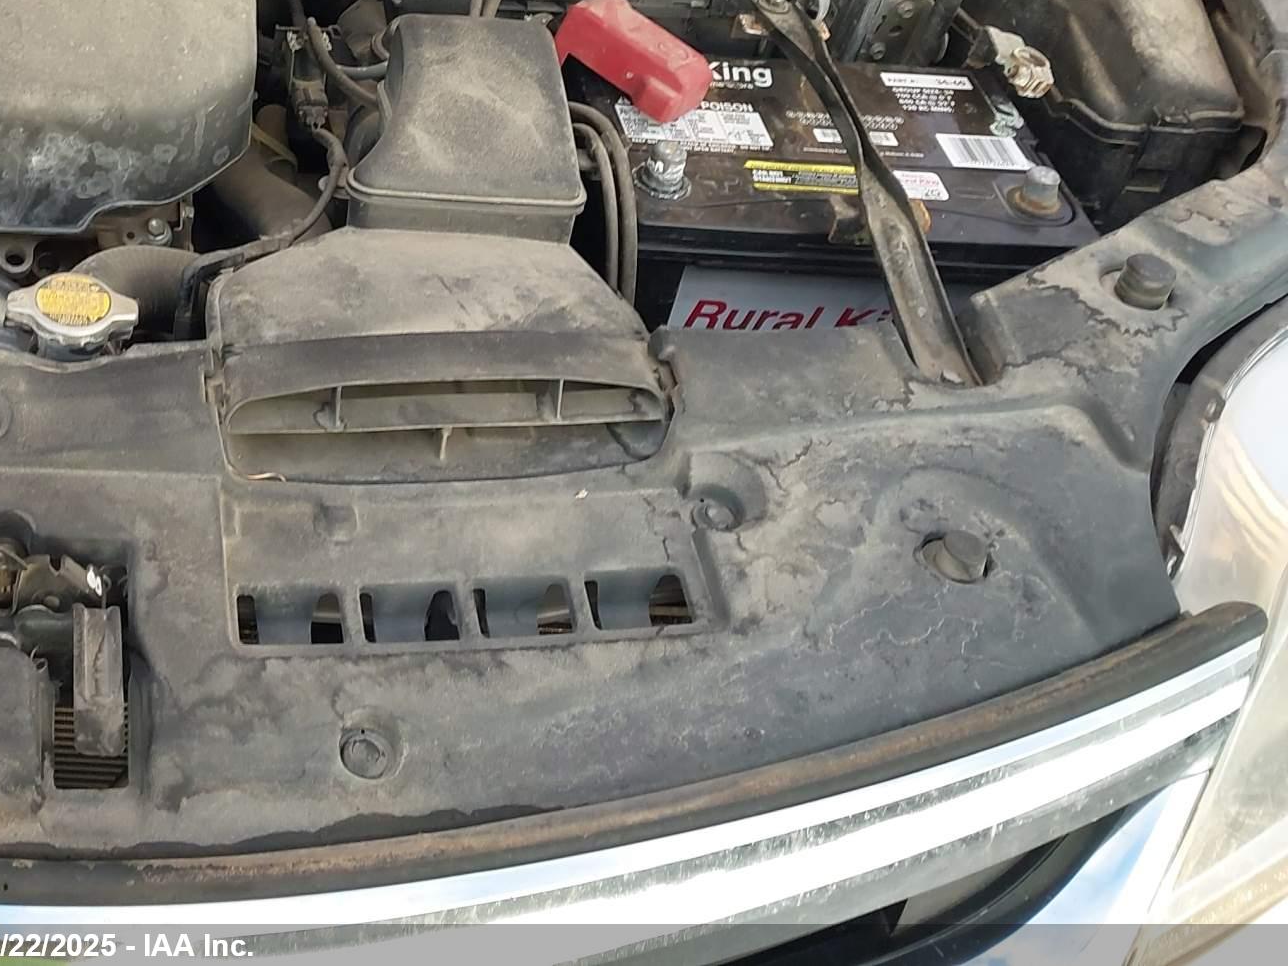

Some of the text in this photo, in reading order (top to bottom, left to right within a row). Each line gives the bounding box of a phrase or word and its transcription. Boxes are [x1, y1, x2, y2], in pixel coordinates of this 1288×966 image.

[709, 61, 773, 88] King
[701, 101, 754, 113] POISON
[683, 299, 825, 331] Rural
